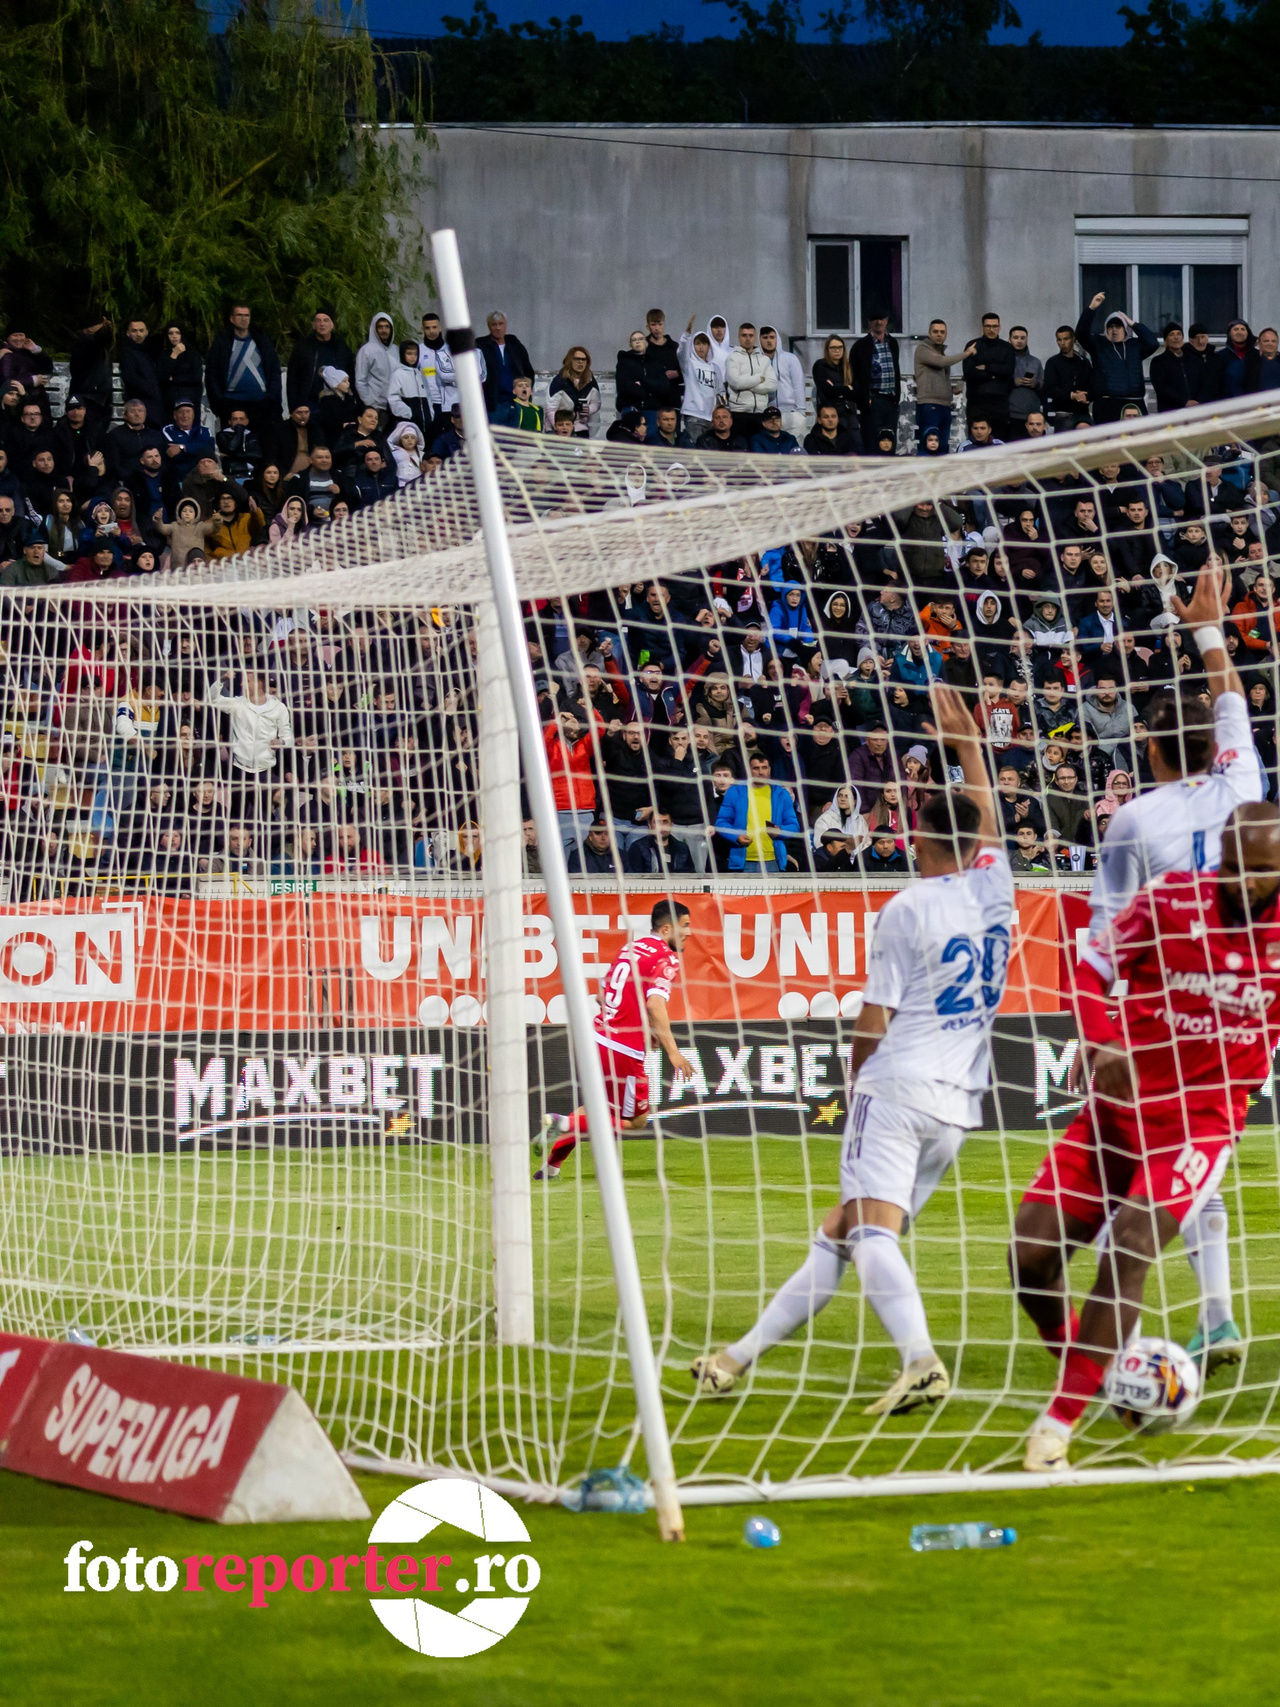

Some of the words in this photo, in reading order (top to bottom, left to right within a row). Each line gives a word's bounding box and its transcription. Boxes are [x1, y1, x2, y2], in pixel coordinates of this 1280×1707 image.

[605, 962, 631, 1008] 9
[935, 924, 1010, 1016] 20
[174, 1054, 443, 1127] MAXBET
[1172, 1141, 1210, 1187] 19
[44, 1363, 240, 1484] SUPERLIGA
